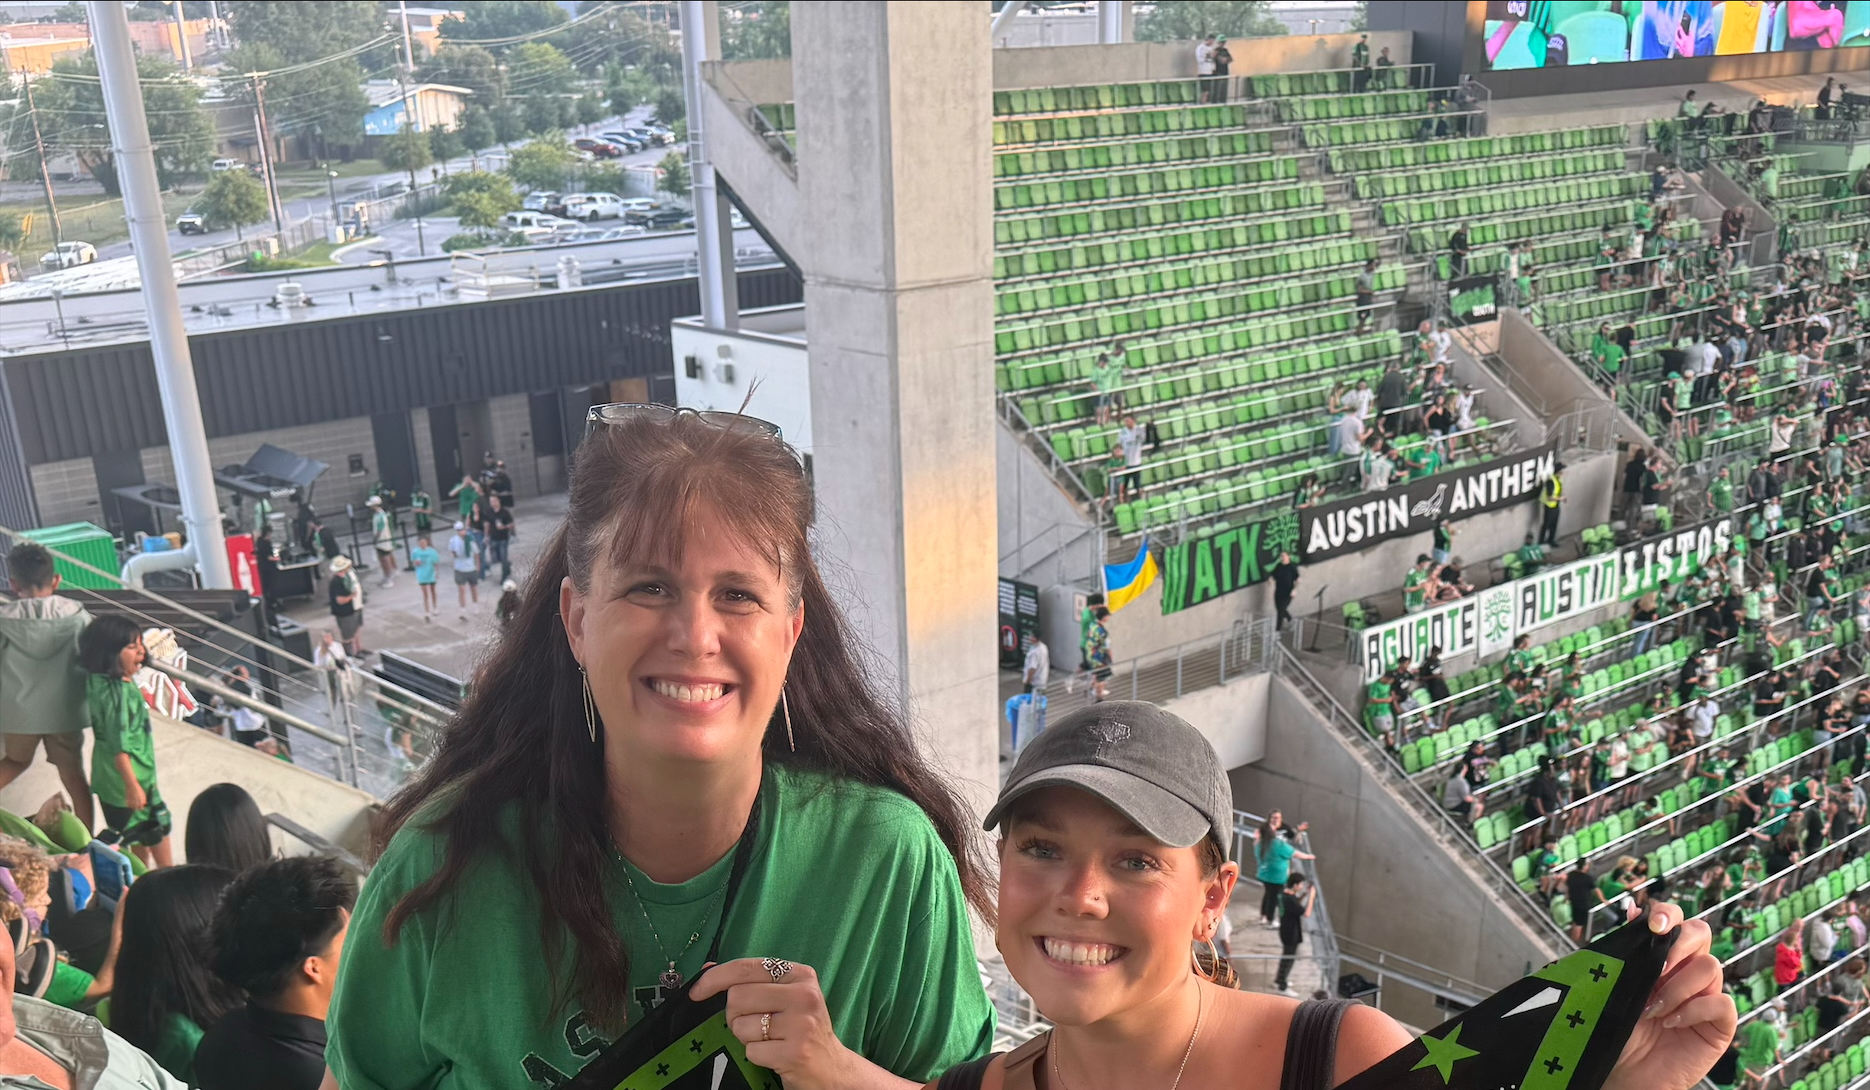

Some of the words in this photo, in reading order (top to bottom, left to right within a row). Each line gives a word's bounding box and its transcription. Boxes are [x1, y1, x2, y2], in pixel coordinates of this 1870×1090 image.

[1306, 494, 1410, 554] AUSTIN
[1450, 450, 1556, 514] ANTHEM
[1192, 523, 1262, 604] ATX
[1521, 558, 1616, 628] AUSTIN
[1621, 519, 1732, 596] LISTOS
